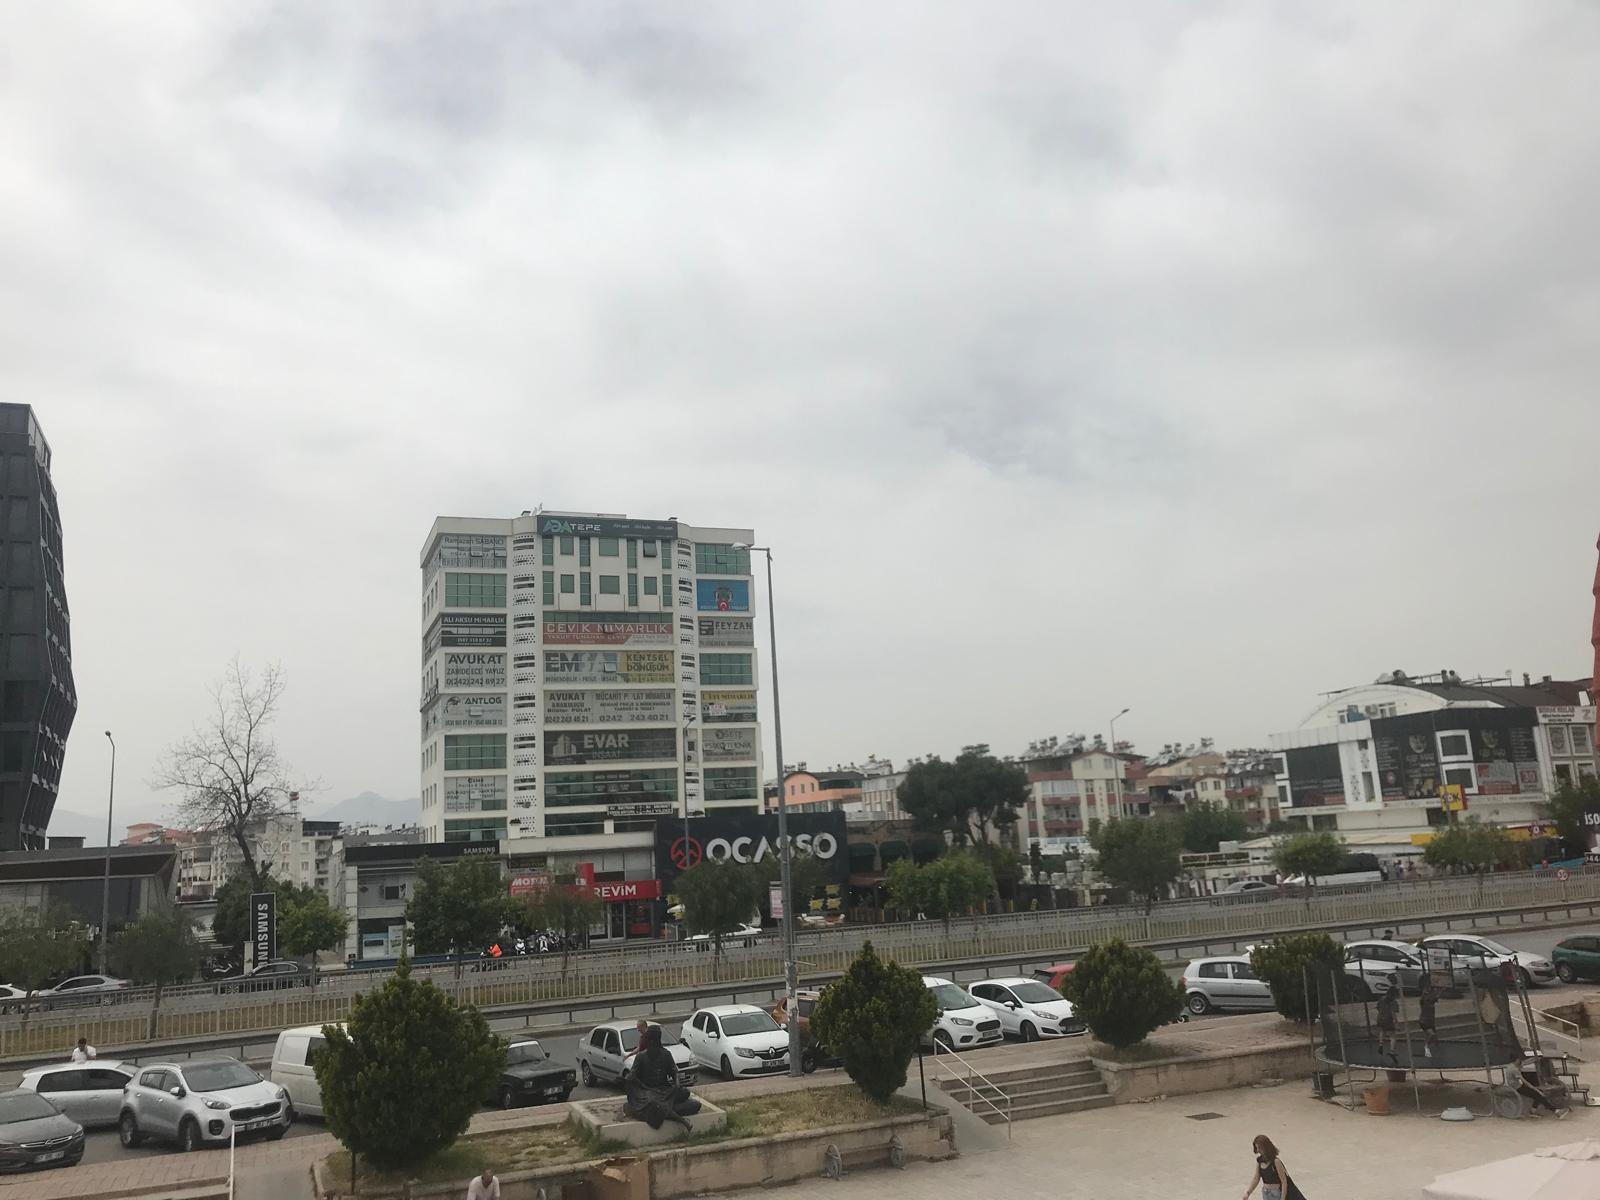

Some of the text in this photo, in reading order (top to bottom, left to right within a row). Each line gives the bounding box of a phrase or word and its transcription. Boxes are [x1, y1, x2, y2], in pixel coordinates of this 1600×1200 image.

[448, 654, 503, 665] AVUKAT
[464, 696, 502, 705] ANTLOG
[549, 692, 585, 701] AVUKAT
[583, 734, 629, 749] EVAR
